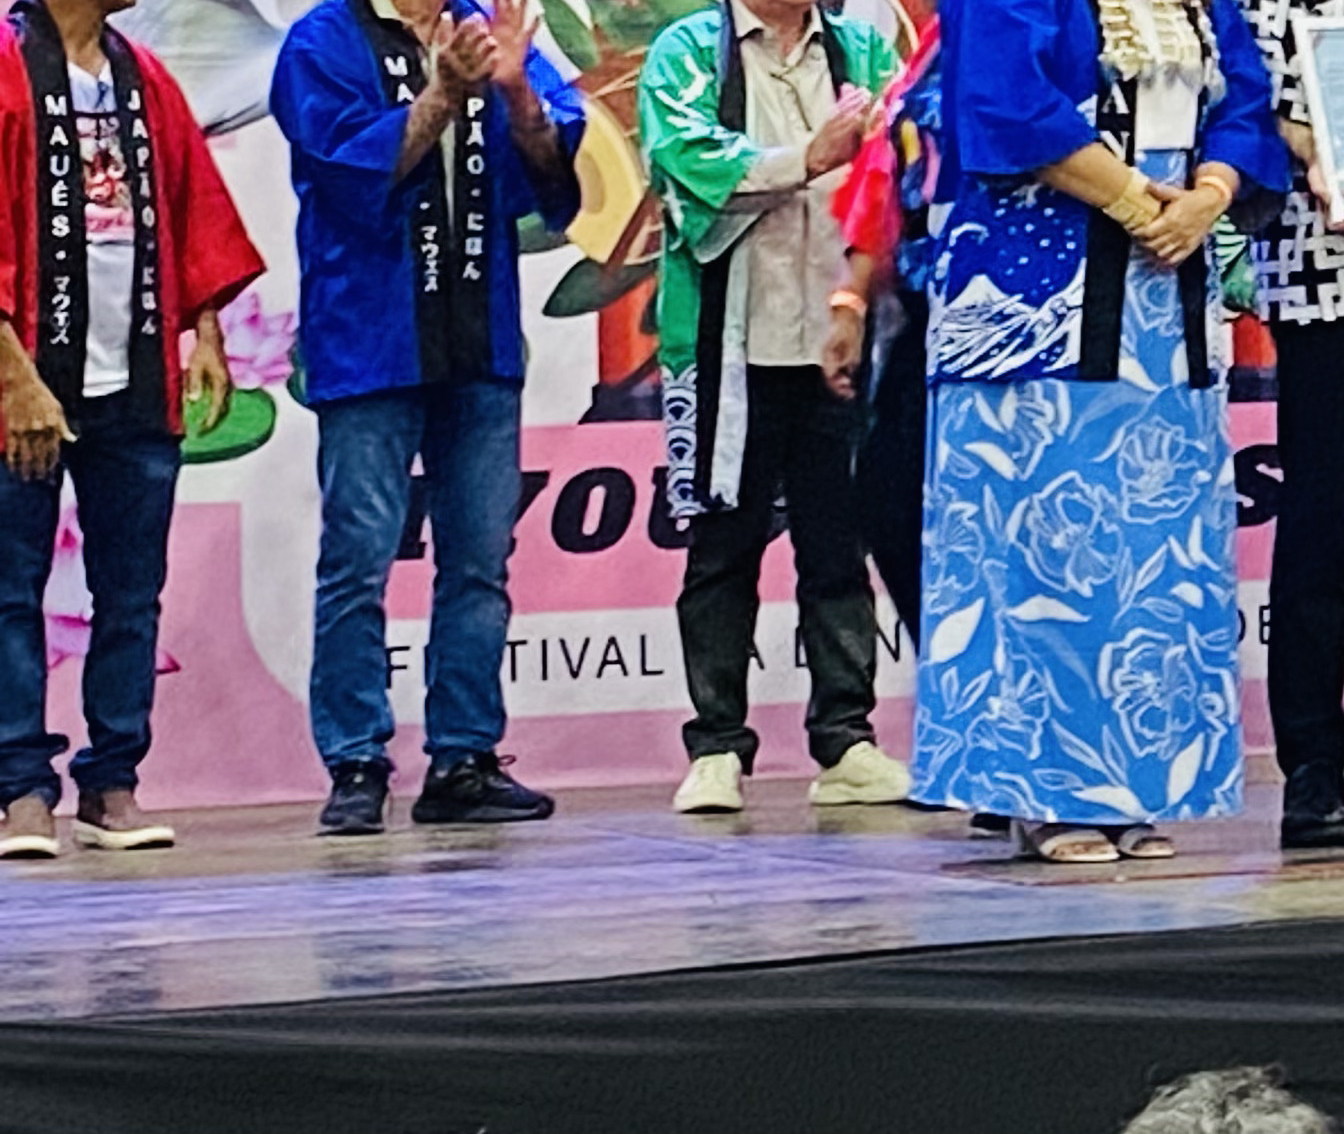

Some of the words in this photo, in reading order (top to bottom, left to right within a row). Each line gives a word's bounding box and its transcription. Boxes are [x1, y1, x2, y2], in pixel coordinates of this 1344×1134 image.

[45, 94, 71, 238] MAUÉS
[466, 97, 485, 175] PÃO
[386, 634, 664, 689] FTIVAL
